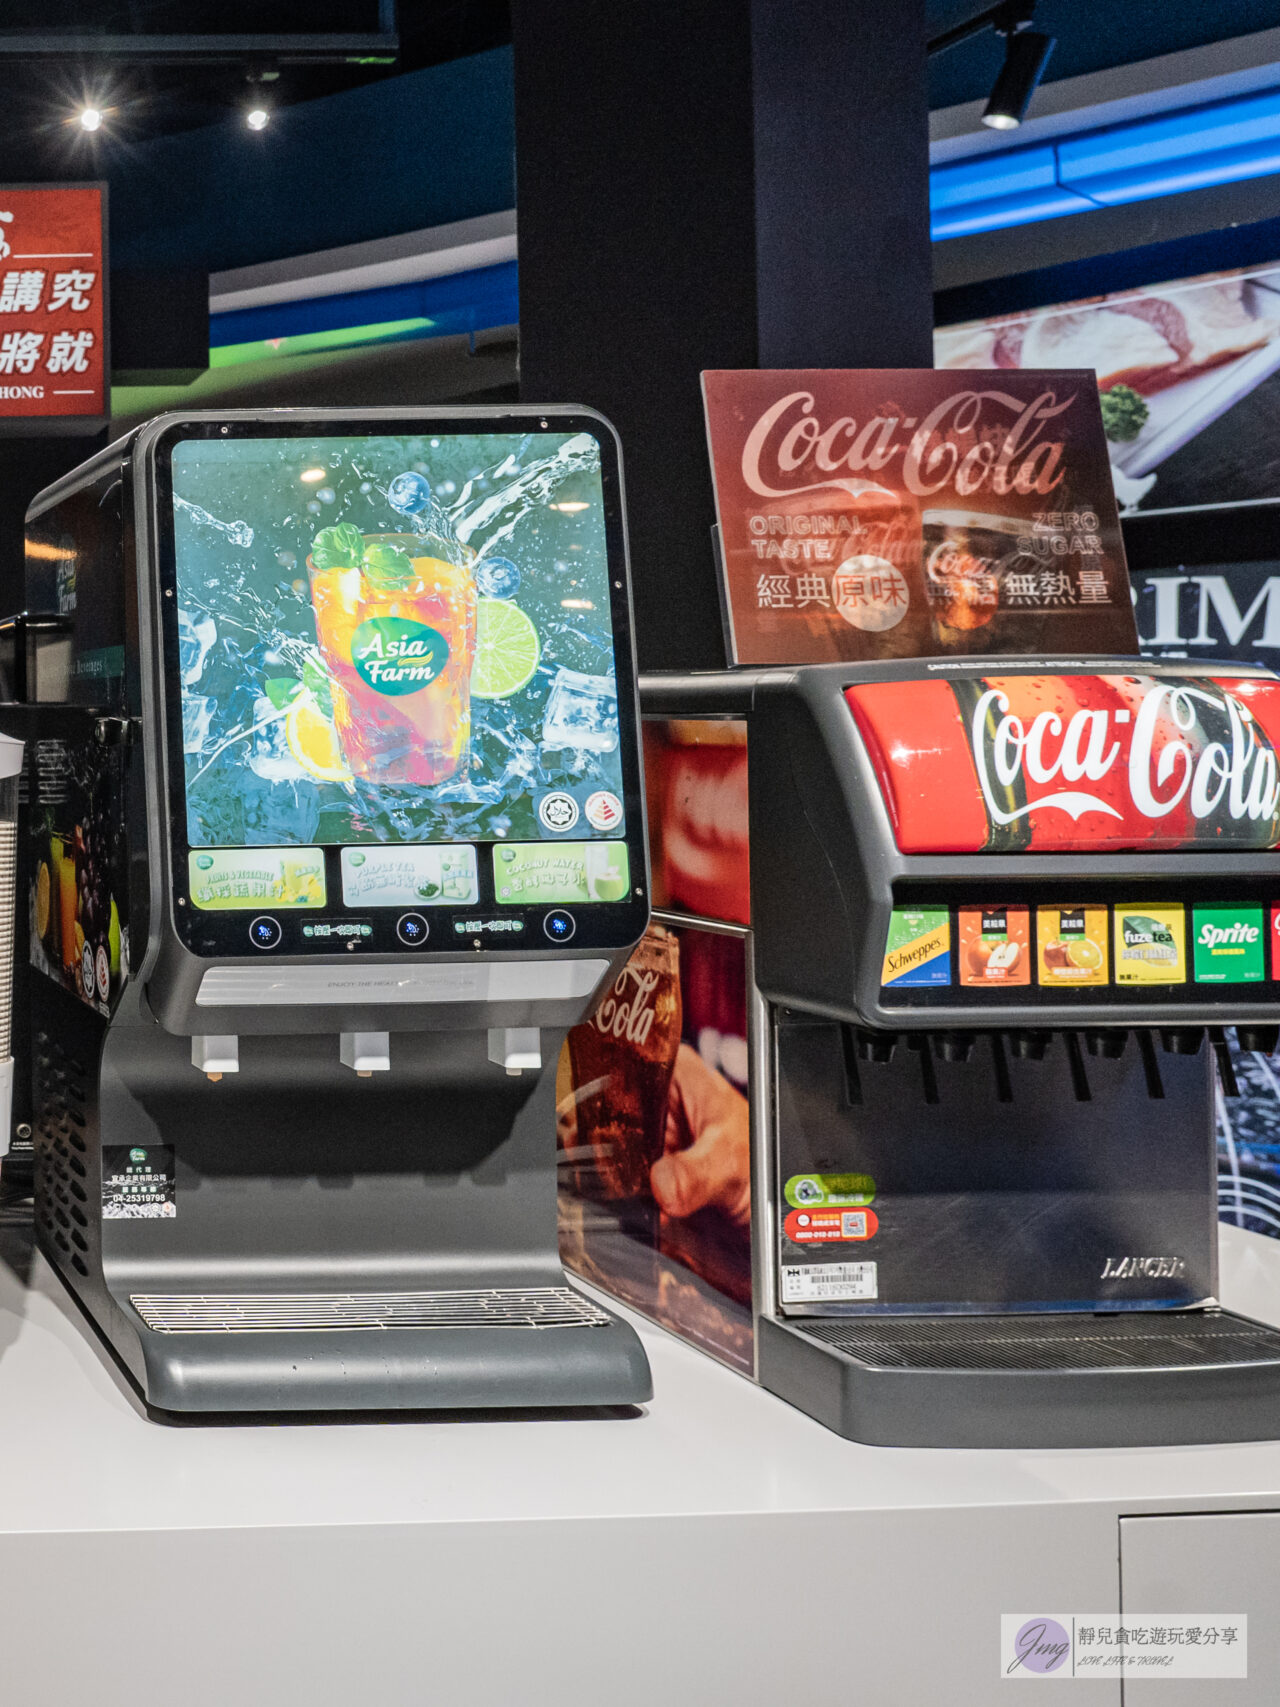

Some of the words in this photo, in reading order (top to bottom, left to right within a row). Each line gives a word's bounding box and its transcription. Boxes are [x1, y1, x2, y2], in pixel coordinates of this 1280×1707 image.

[742, 391, 1077, 498] Coca-Cola
[749, 515, 868, 535] ORIGINAL
[1032, 511, 1100, 532] ZERO
[751, 539, 832, 559] TASTE
[1016, 535, 1105, 555] SUGAR
[756, 573, 907, 608] 經典原味
[1005, 570, 1112, 605] 無熱量
[1130, 575, 1280, 646] IM
[357, 633, 428, 659] Asia
[364, 660, 435, 684] Farm
[973, 685, 1280, 825] Coca-Cola
[1198, 922, 1259, 948] Sprite
[888, 937, 942, 973] Schweppes
